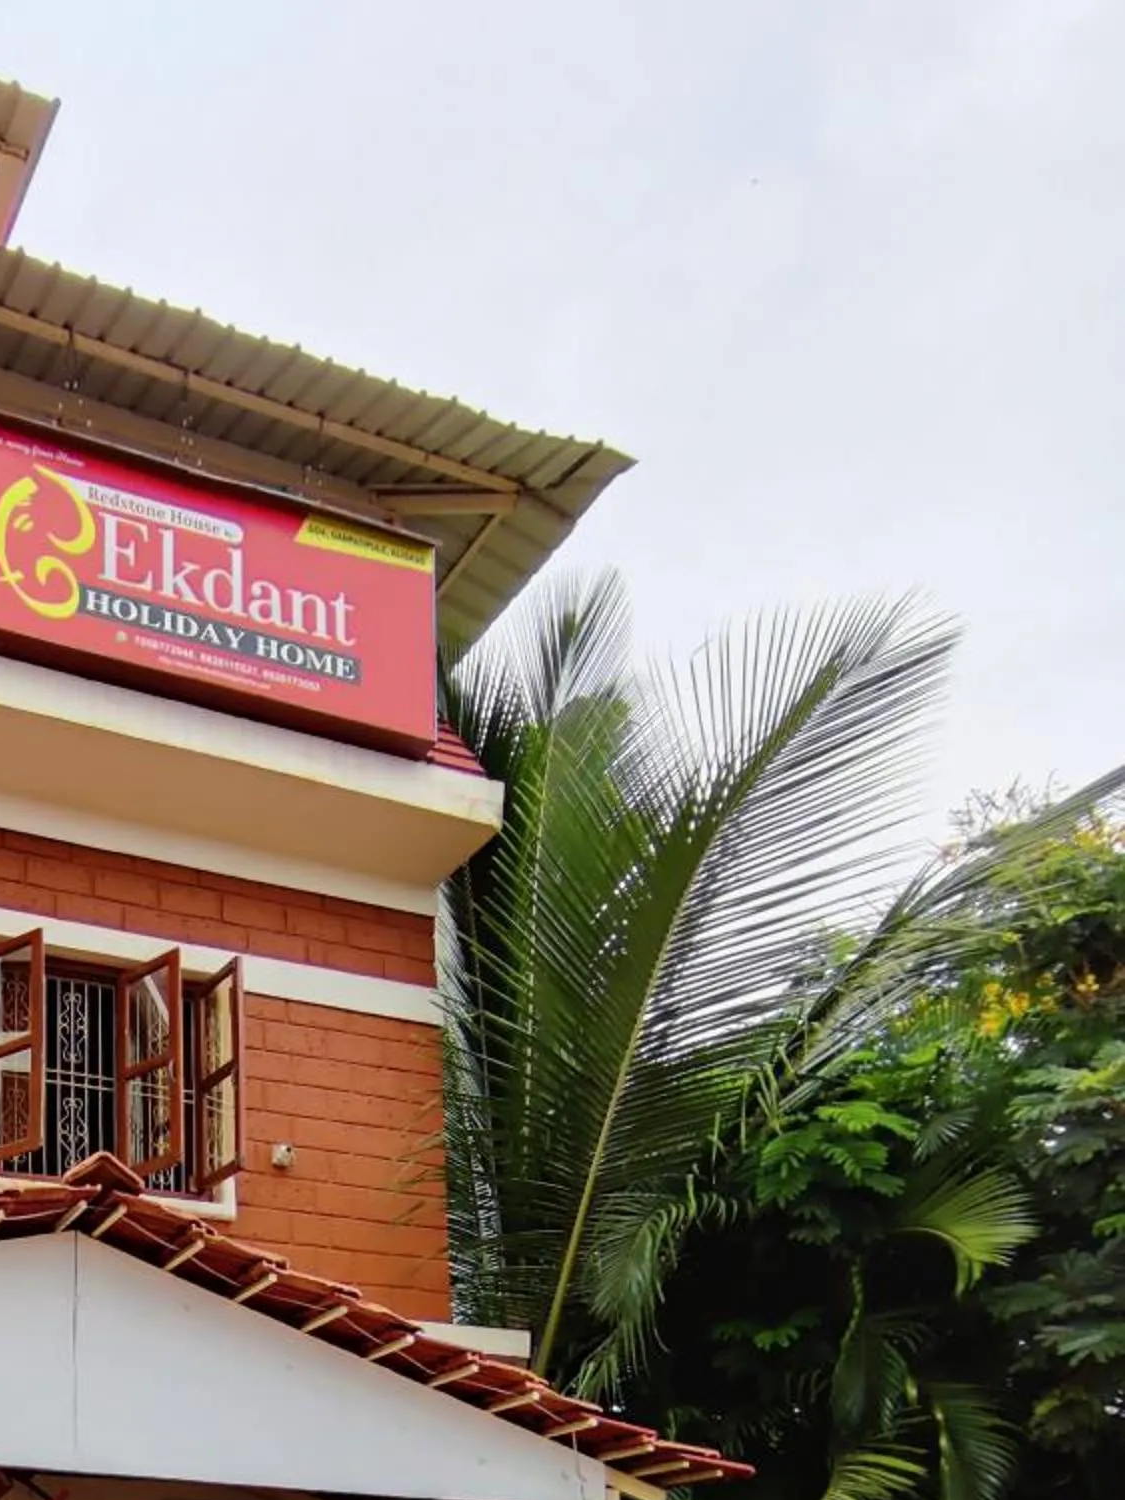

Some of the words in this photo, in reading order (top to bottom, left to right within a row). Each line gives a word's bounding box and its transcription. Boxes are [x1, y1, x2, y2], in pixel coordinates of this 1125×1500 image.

[87, 485, 166, 519] Redstone
[170, 508, 220, 534] House
[97, 511, 357, 646] Ekdant
[83, 588, 246, 652] HOLIDAY
[256, 635, 358, 681] HOME
